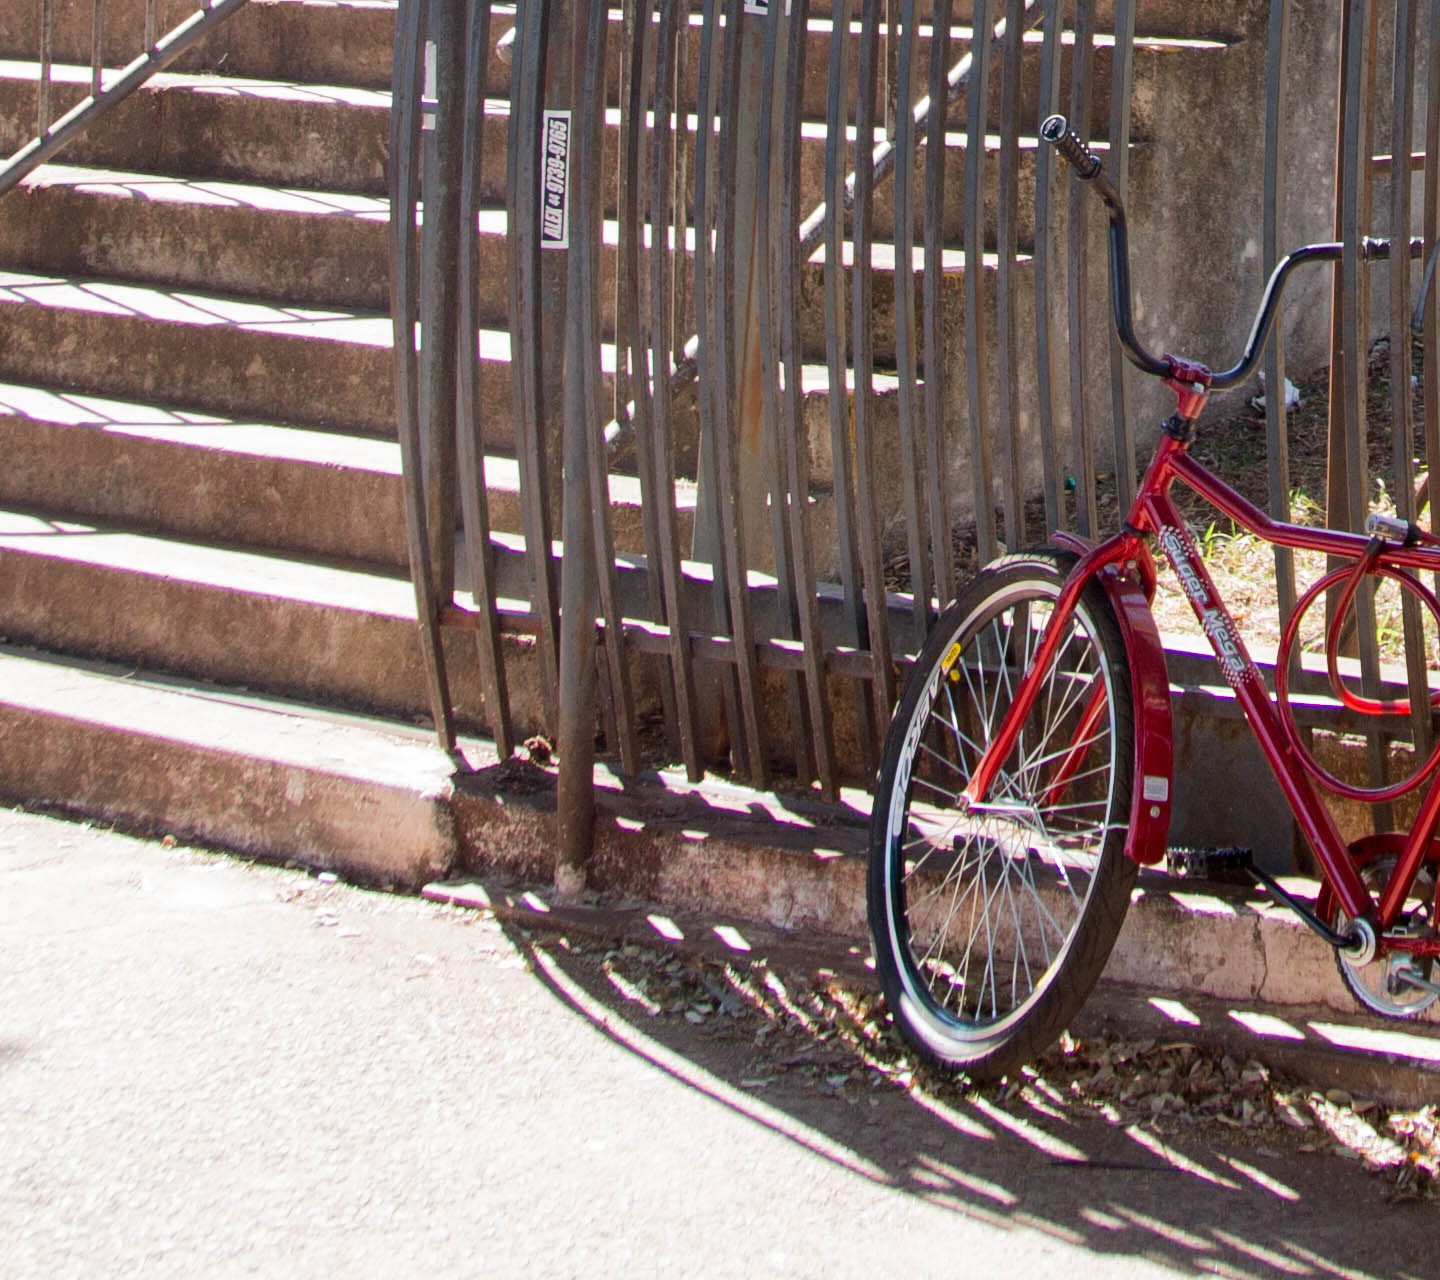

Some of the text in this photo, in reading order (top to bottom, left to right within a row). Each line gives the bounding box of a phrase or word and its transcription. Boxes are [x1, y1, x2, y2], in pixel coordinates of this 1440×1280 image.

[545, 119, 568, 195] 9739-9765
[543, 204, 563, 240] ALEX
[1163, 533, 1246, 672] Super Mega
